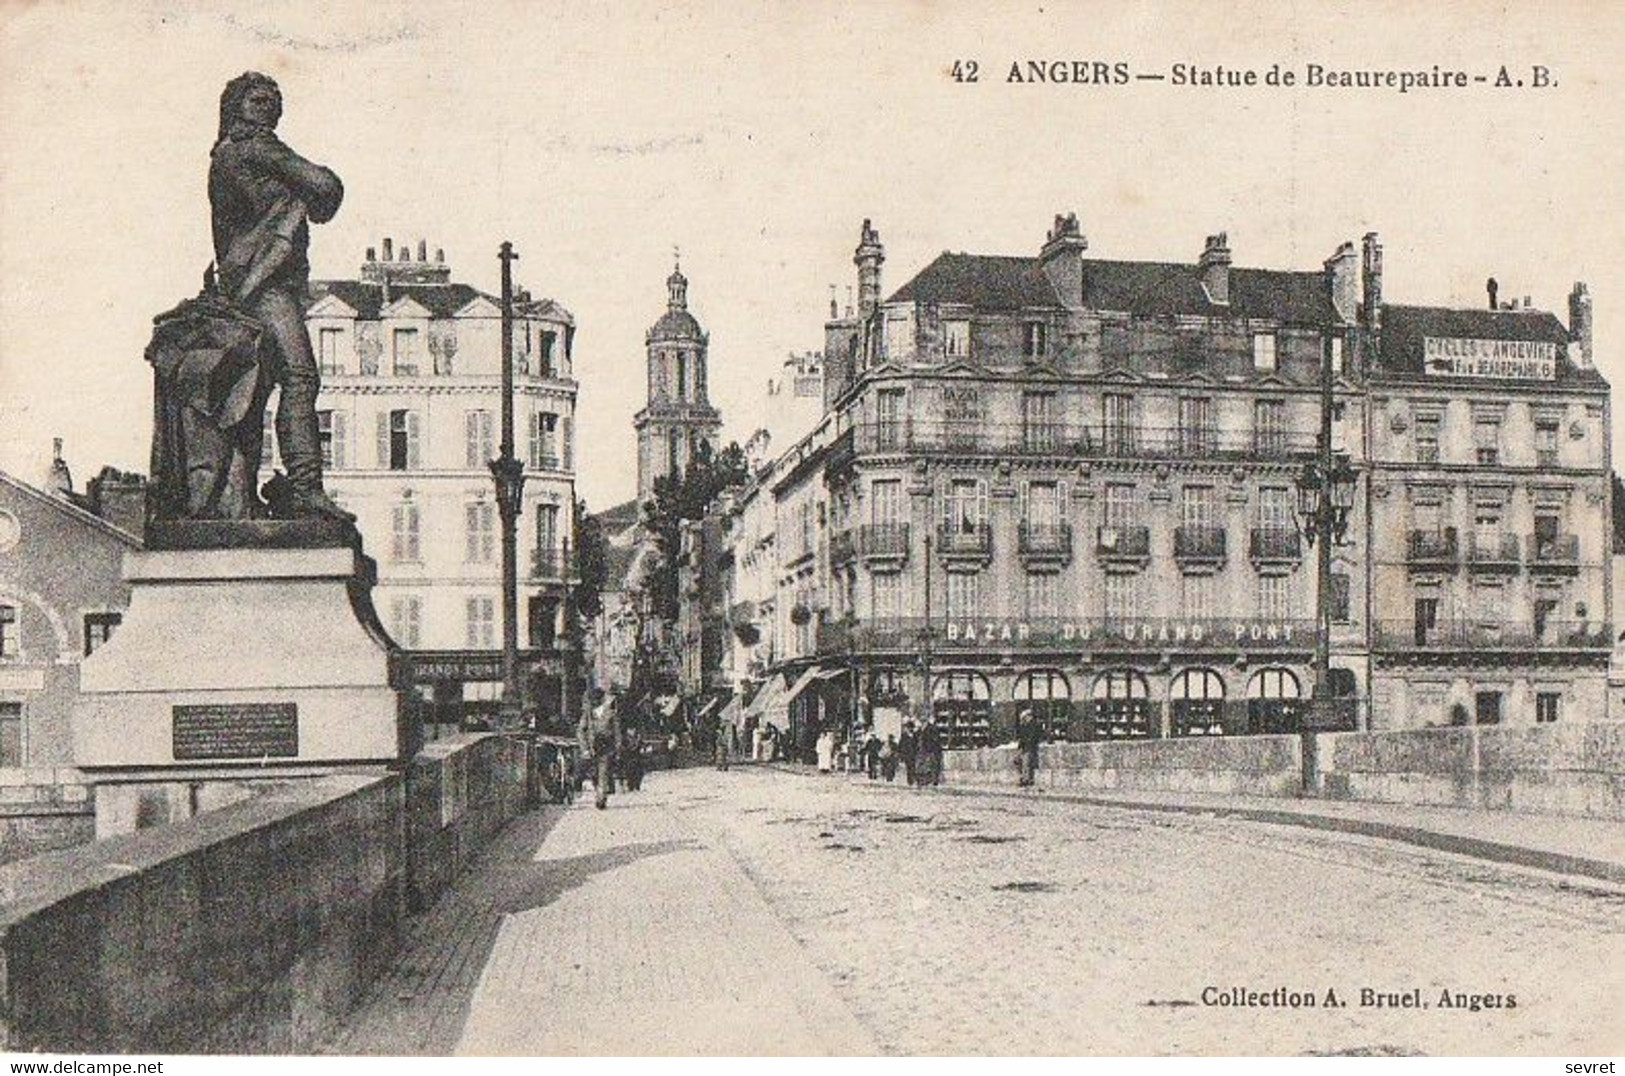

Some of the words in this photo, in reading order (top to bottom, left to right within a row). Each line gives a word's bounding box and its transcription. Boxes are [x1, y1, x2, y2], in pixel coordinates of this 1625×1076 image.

[947, 623, 1030, 641] BAZAR
[1062, 623, 1092, 641] DU
[1123, 624, 1203, 642] GRAND
[1234, 624, 1294, 642] PONT
